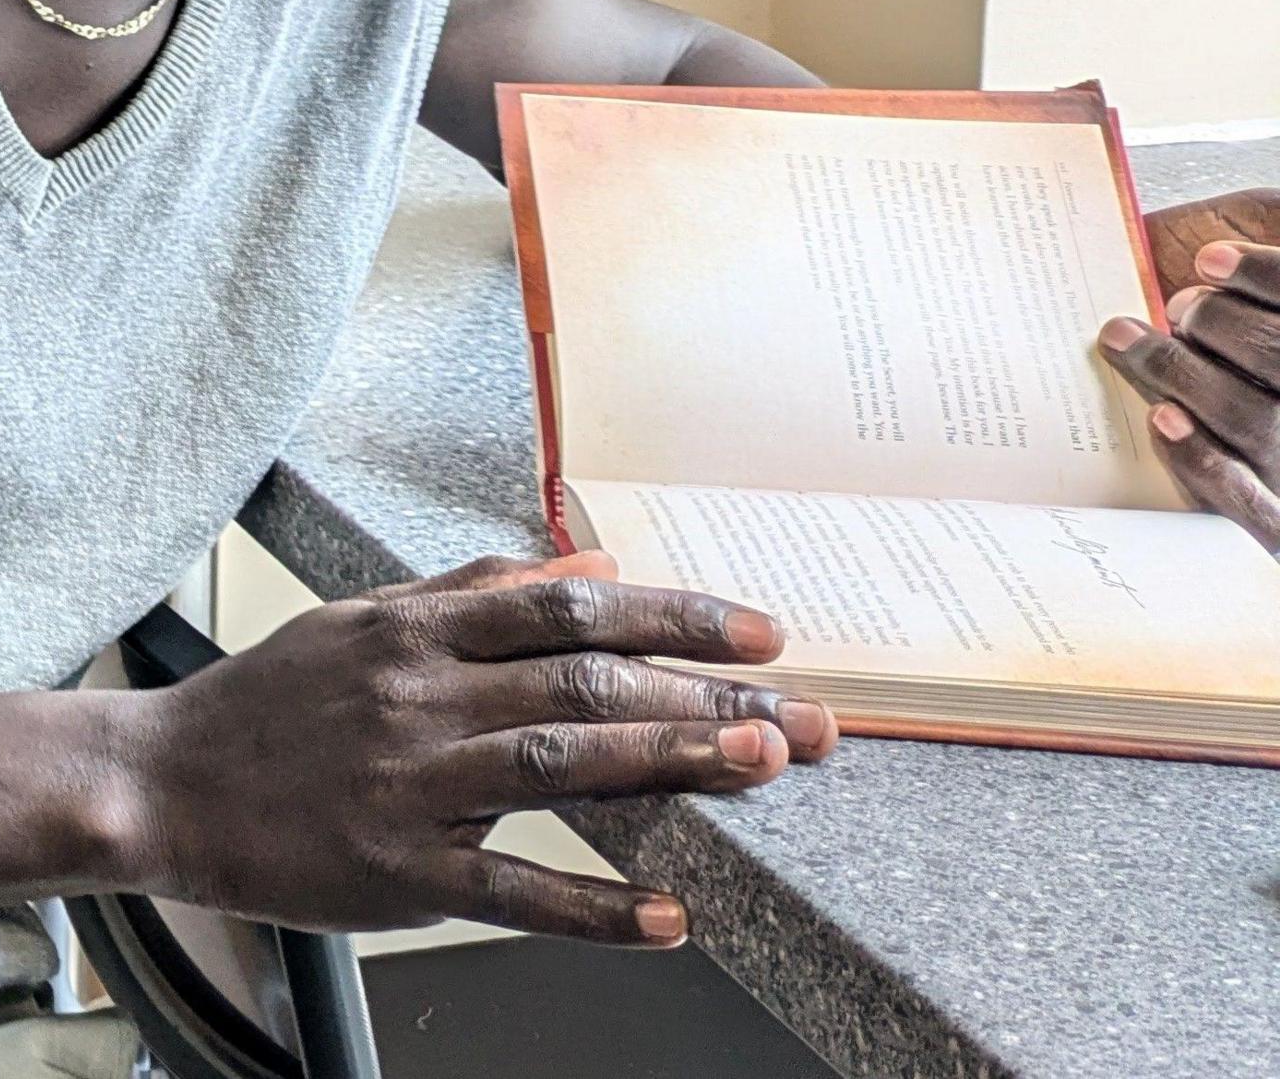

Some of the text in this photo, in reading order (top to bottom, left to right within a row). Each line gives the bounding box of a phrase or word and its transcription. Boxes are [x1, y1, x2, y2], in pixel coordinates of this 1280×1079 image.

[852, 392, 866, 421] know
[886, 399, 900, 421] you
[937, 383, 959, 445] because The
[856, 423, 870, 441] the
[873, 421, 887, 441] You
[891, 422, 905, 442] will
[963, 430, 976, 446] for
[997, 422, 1012, 447] want
[1015, 423, 1029, 449] have
[1068, 424, 1082, 445] that
[1090, 442, 1101, 452] in
